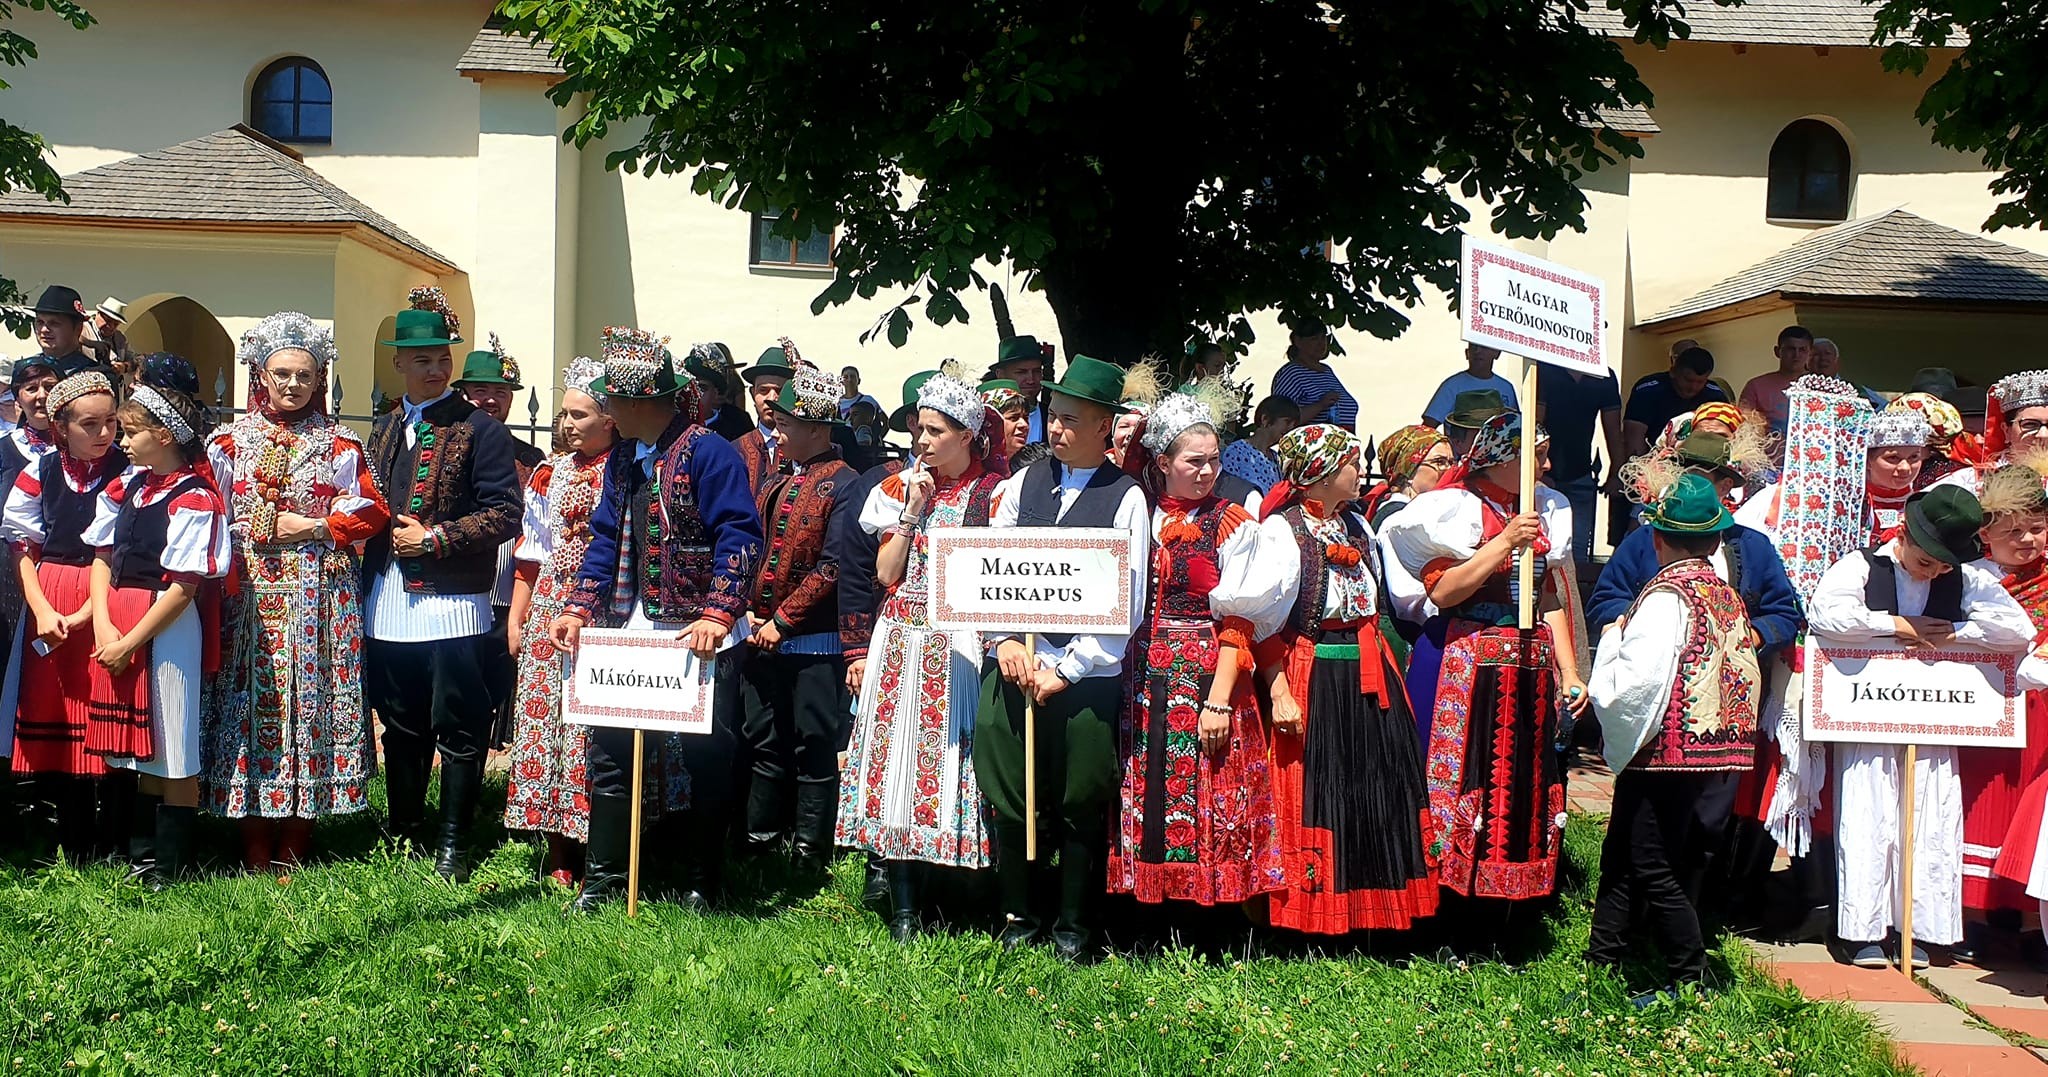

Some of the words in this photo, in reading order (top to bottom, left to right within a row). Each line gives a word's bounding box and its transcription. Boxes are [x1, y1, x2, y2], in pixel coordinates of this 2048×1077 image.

[1508, 280, 1569, 315] MAGYAR
[1479, 300, 1594, 346] GYERŐMONOSTOR
[980, 557, 1081, 577] MAGYAR-
[980, 587, 1083, 602] KISKAPUS
[590, 667, 683, 690] MÁKÓFALVA
[1850, 682, 1976, 704] JÁKÓTELKE
